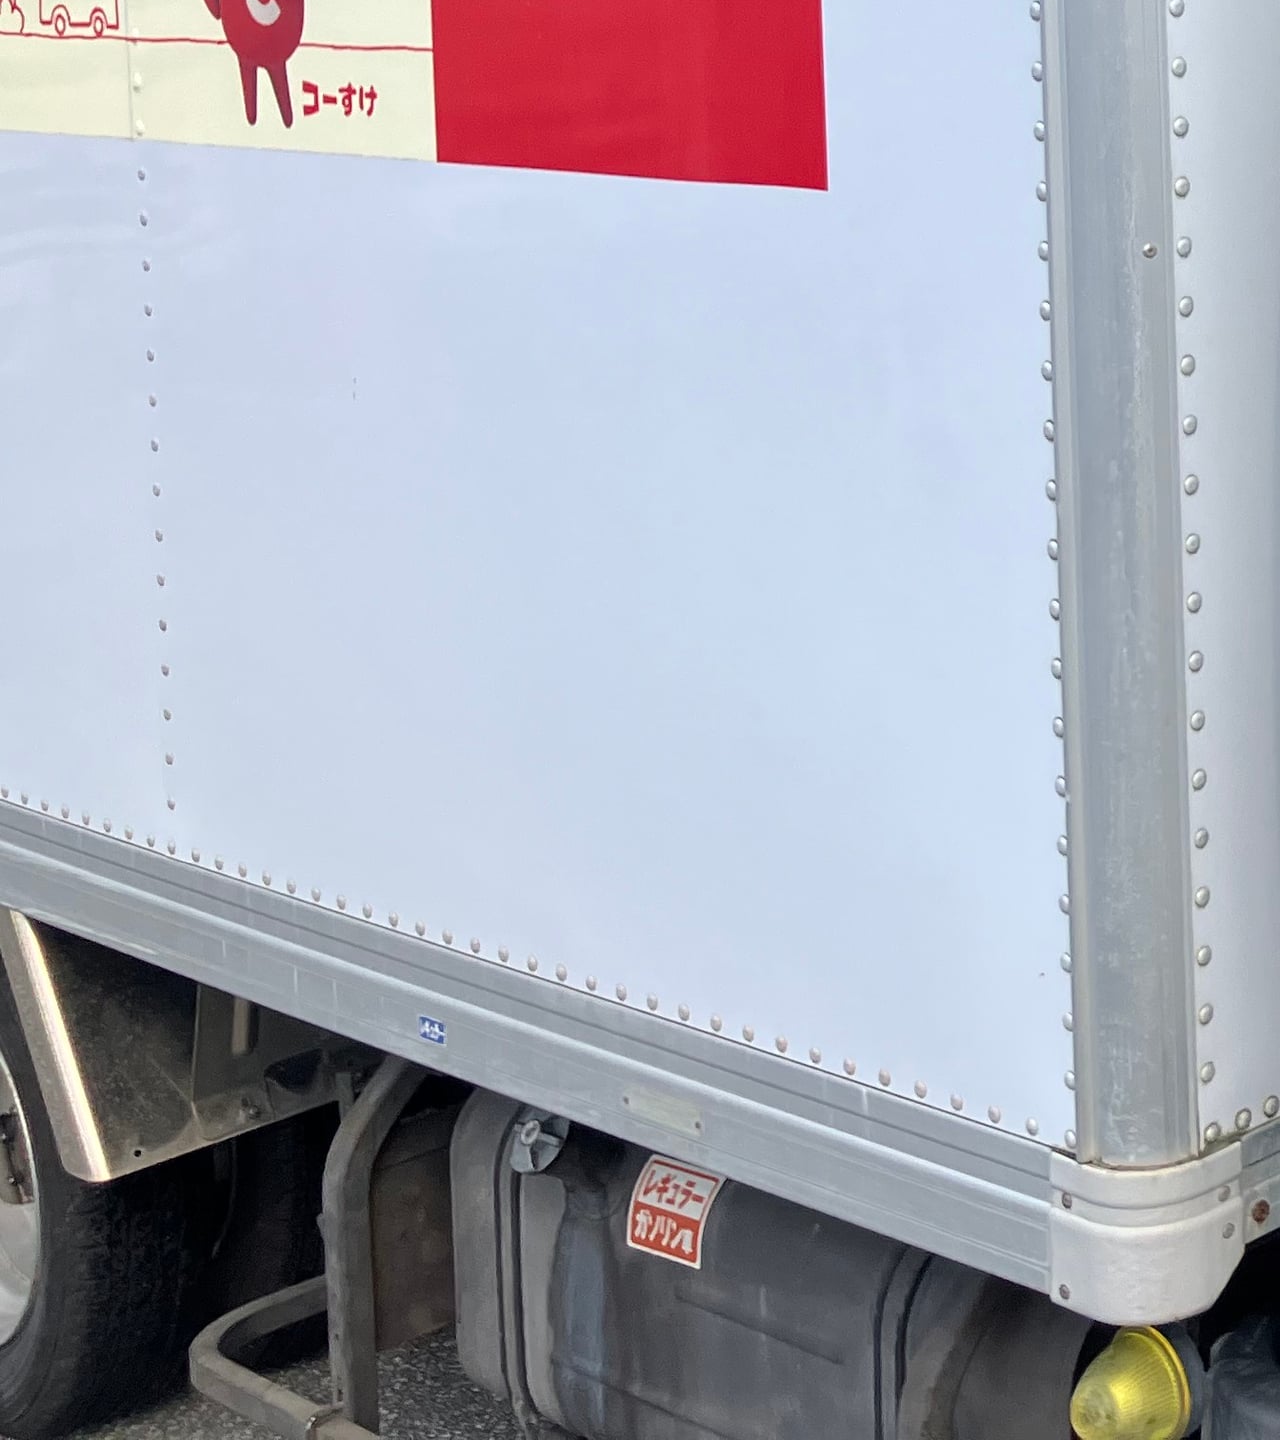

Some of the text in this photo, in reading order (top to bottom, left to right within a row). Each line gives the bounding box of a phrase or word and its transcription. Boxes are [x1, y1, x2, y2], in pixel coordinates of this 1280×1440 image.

[302, 80, 378, 117] コーすけ
[643, 1170, 705, 1210] レギュラー
